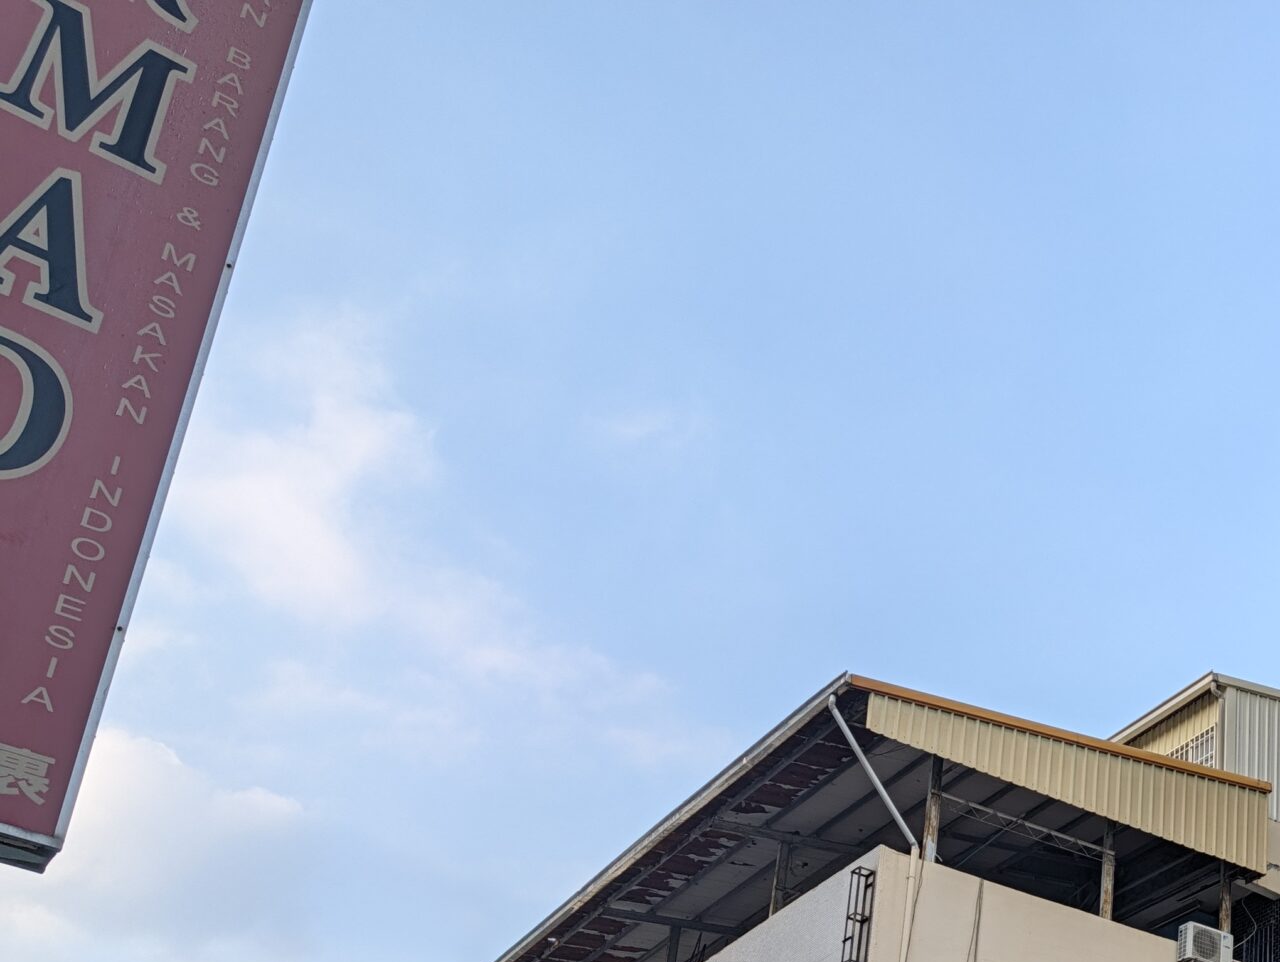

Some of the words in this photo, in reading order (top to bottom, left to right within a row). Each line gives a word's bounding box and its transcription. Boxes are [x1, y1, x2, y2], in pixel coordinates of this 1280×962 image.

[190, 46, 251, 187] BARANG
[177, 207, 201, 231] &
[115, 242, 196, 425] MASAKAN
[21, 455, 123, 713] INDONESIA
